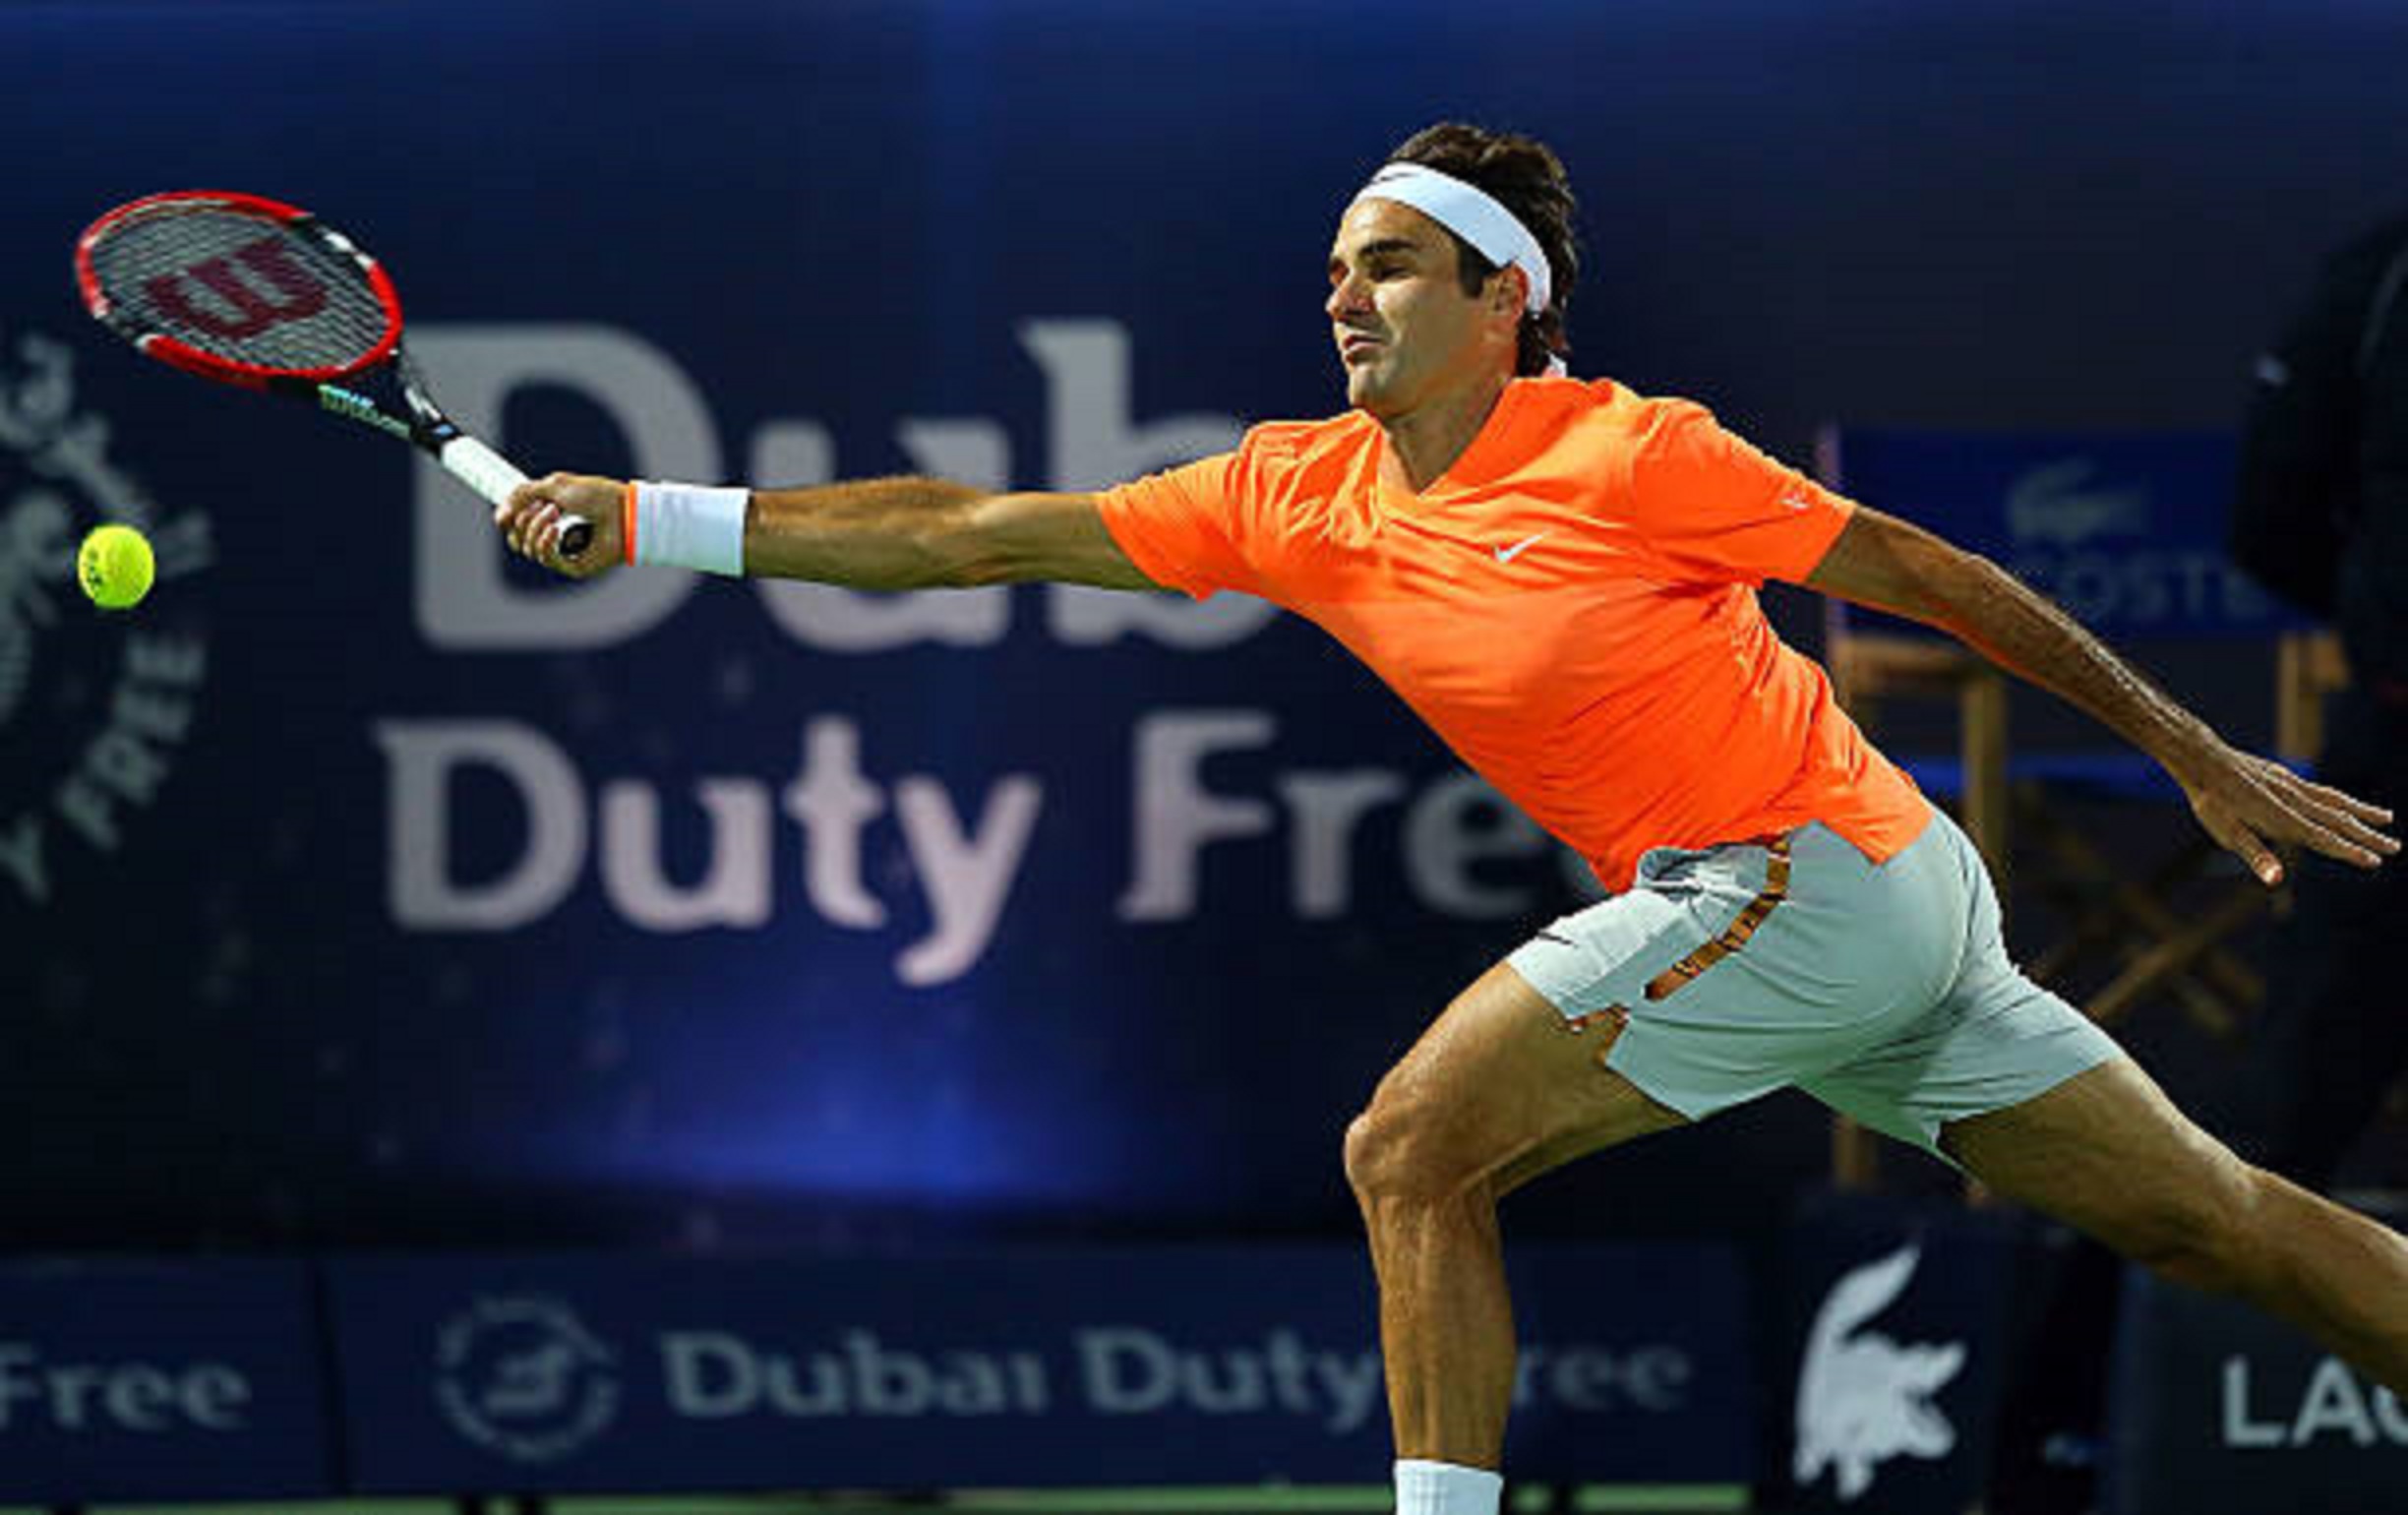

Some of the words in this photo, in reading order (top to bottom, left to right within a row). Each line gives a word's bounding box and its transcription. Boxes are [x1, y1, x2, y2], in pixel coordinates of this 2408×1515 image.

[370, 714, 1043, 988] Duty
[0, 1341, 251, 1429] Free
[663, 1330, 1047, 1418] Dubai
[1076, 1328, 1381, 1433] Duty
[1516, 1345, 1692, 1415] ree
